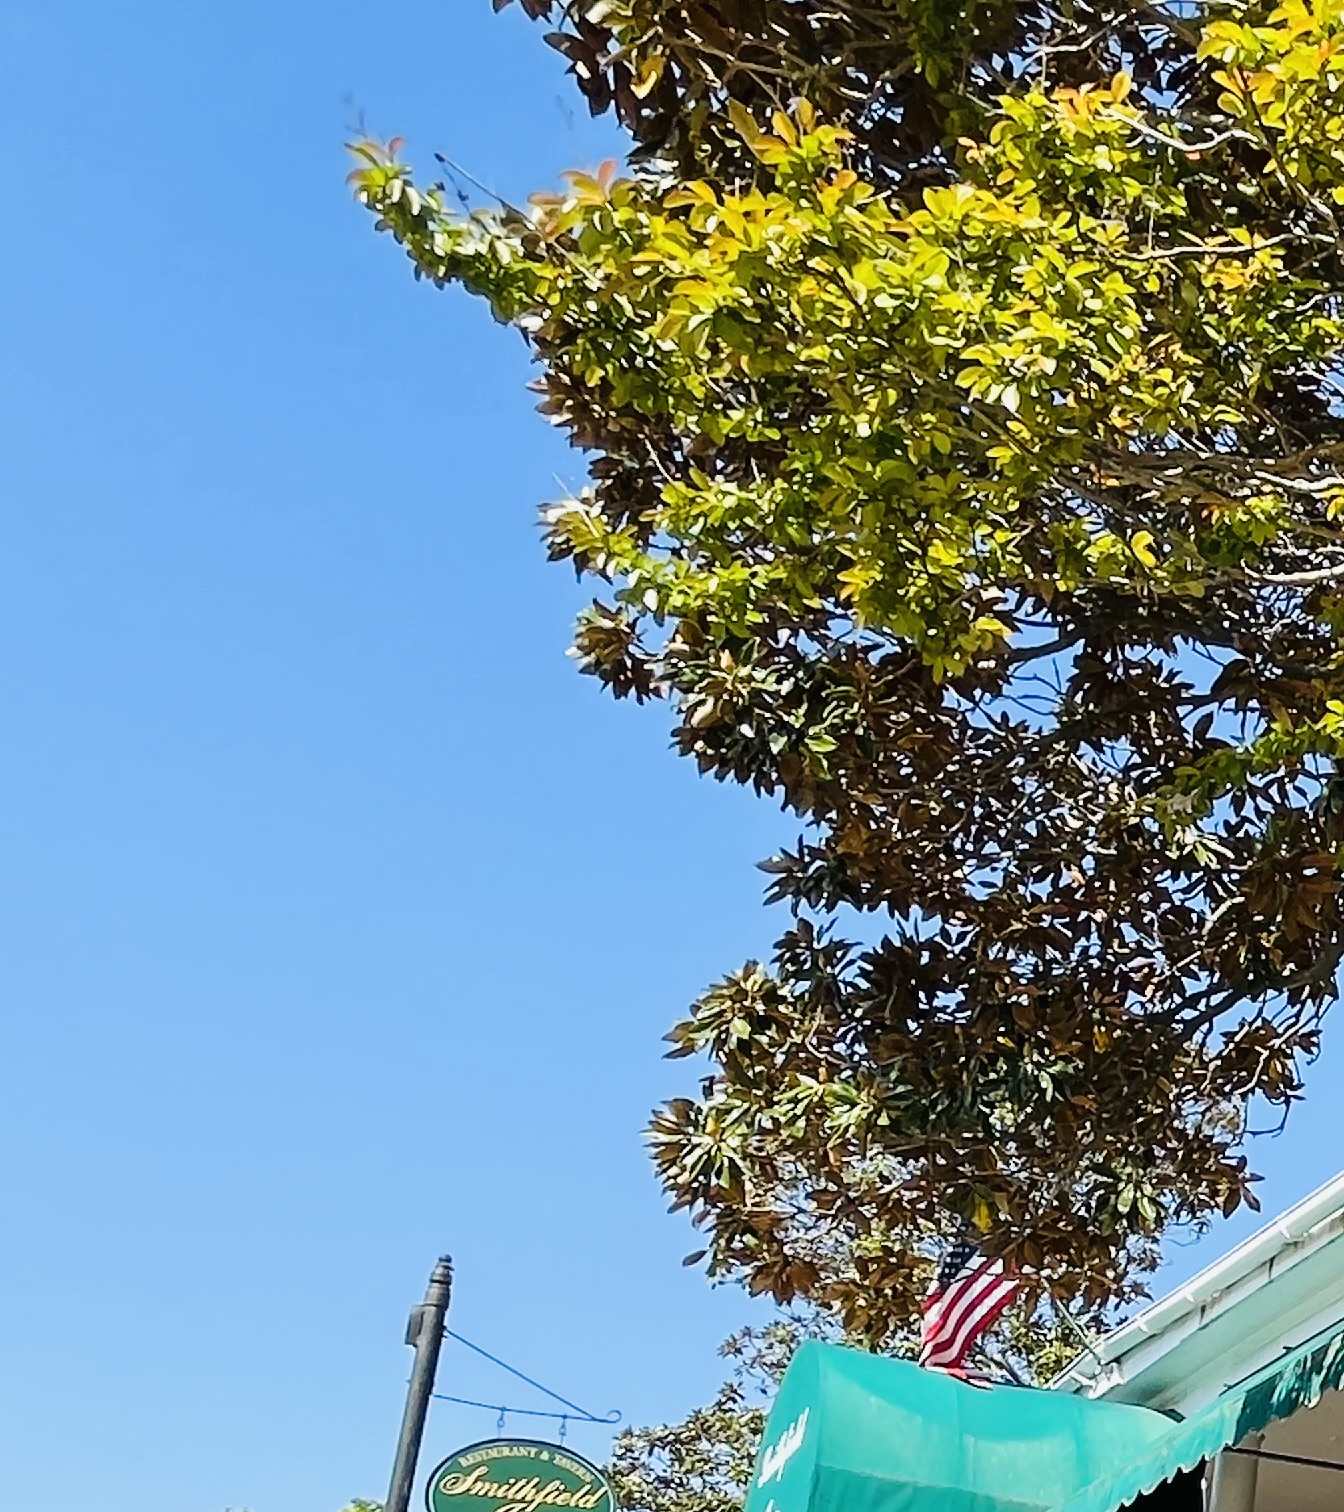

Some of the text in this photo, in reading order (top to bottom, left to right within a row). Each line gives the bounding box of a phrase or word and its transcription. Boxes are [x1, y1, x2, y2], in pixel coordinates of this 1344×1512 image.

[458, 1446, 538, 1467] RESTAURANT
[540, 1450, 550, 1462] &
[439, 1465, 609, 1512] Smithfield
